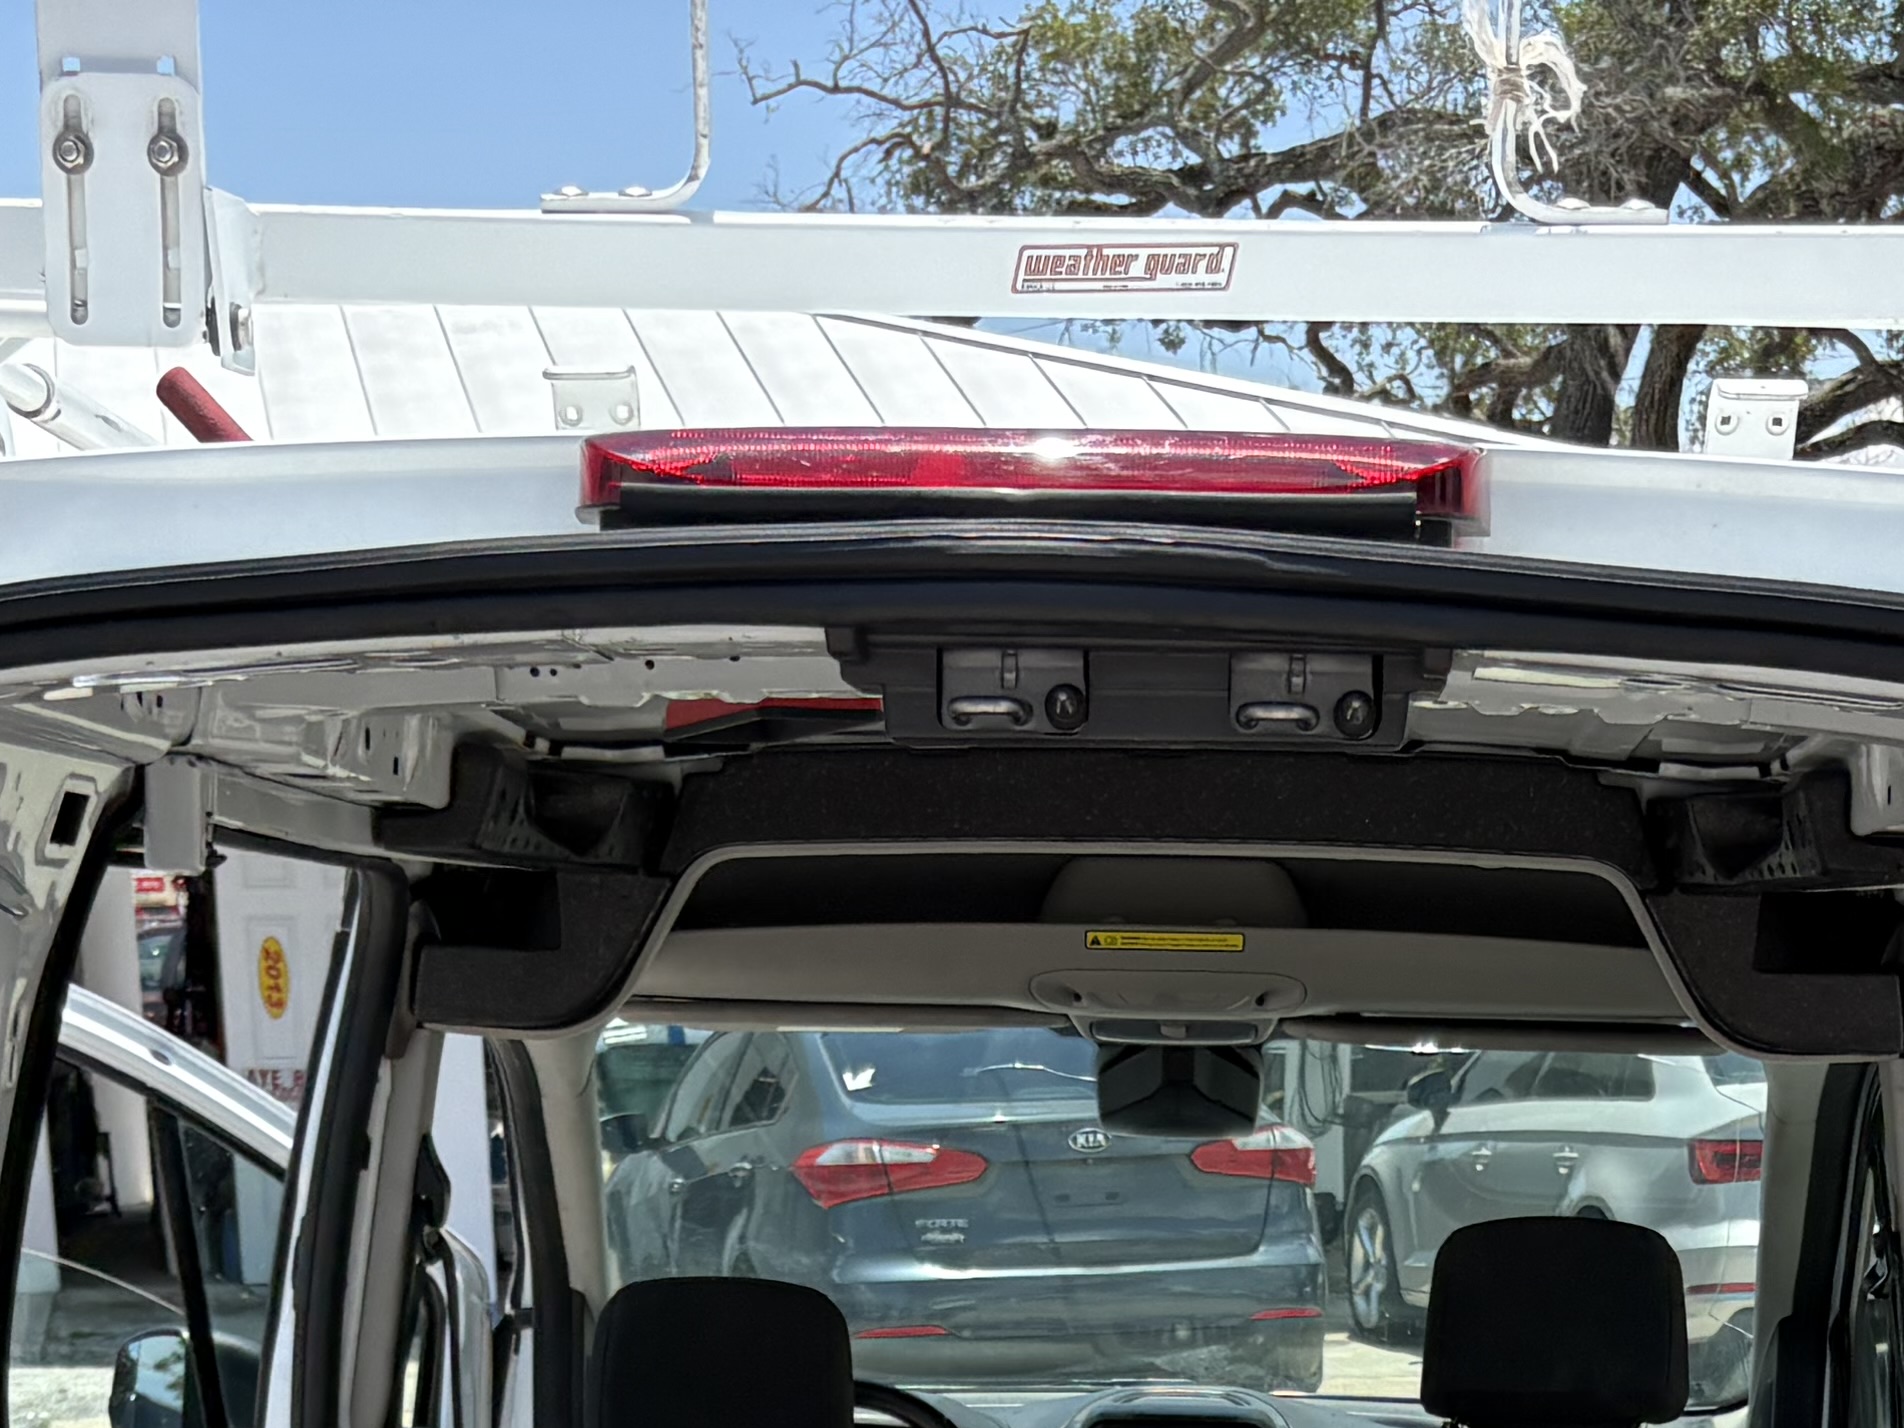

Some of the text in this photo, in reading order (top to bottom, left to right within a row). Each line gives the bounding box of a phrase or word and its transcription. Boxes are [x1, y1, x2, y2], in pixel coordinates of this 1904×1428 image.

[1024, 247, 1223, 281] weather guard
[1075, 1133, 1106, 1149] KIA
